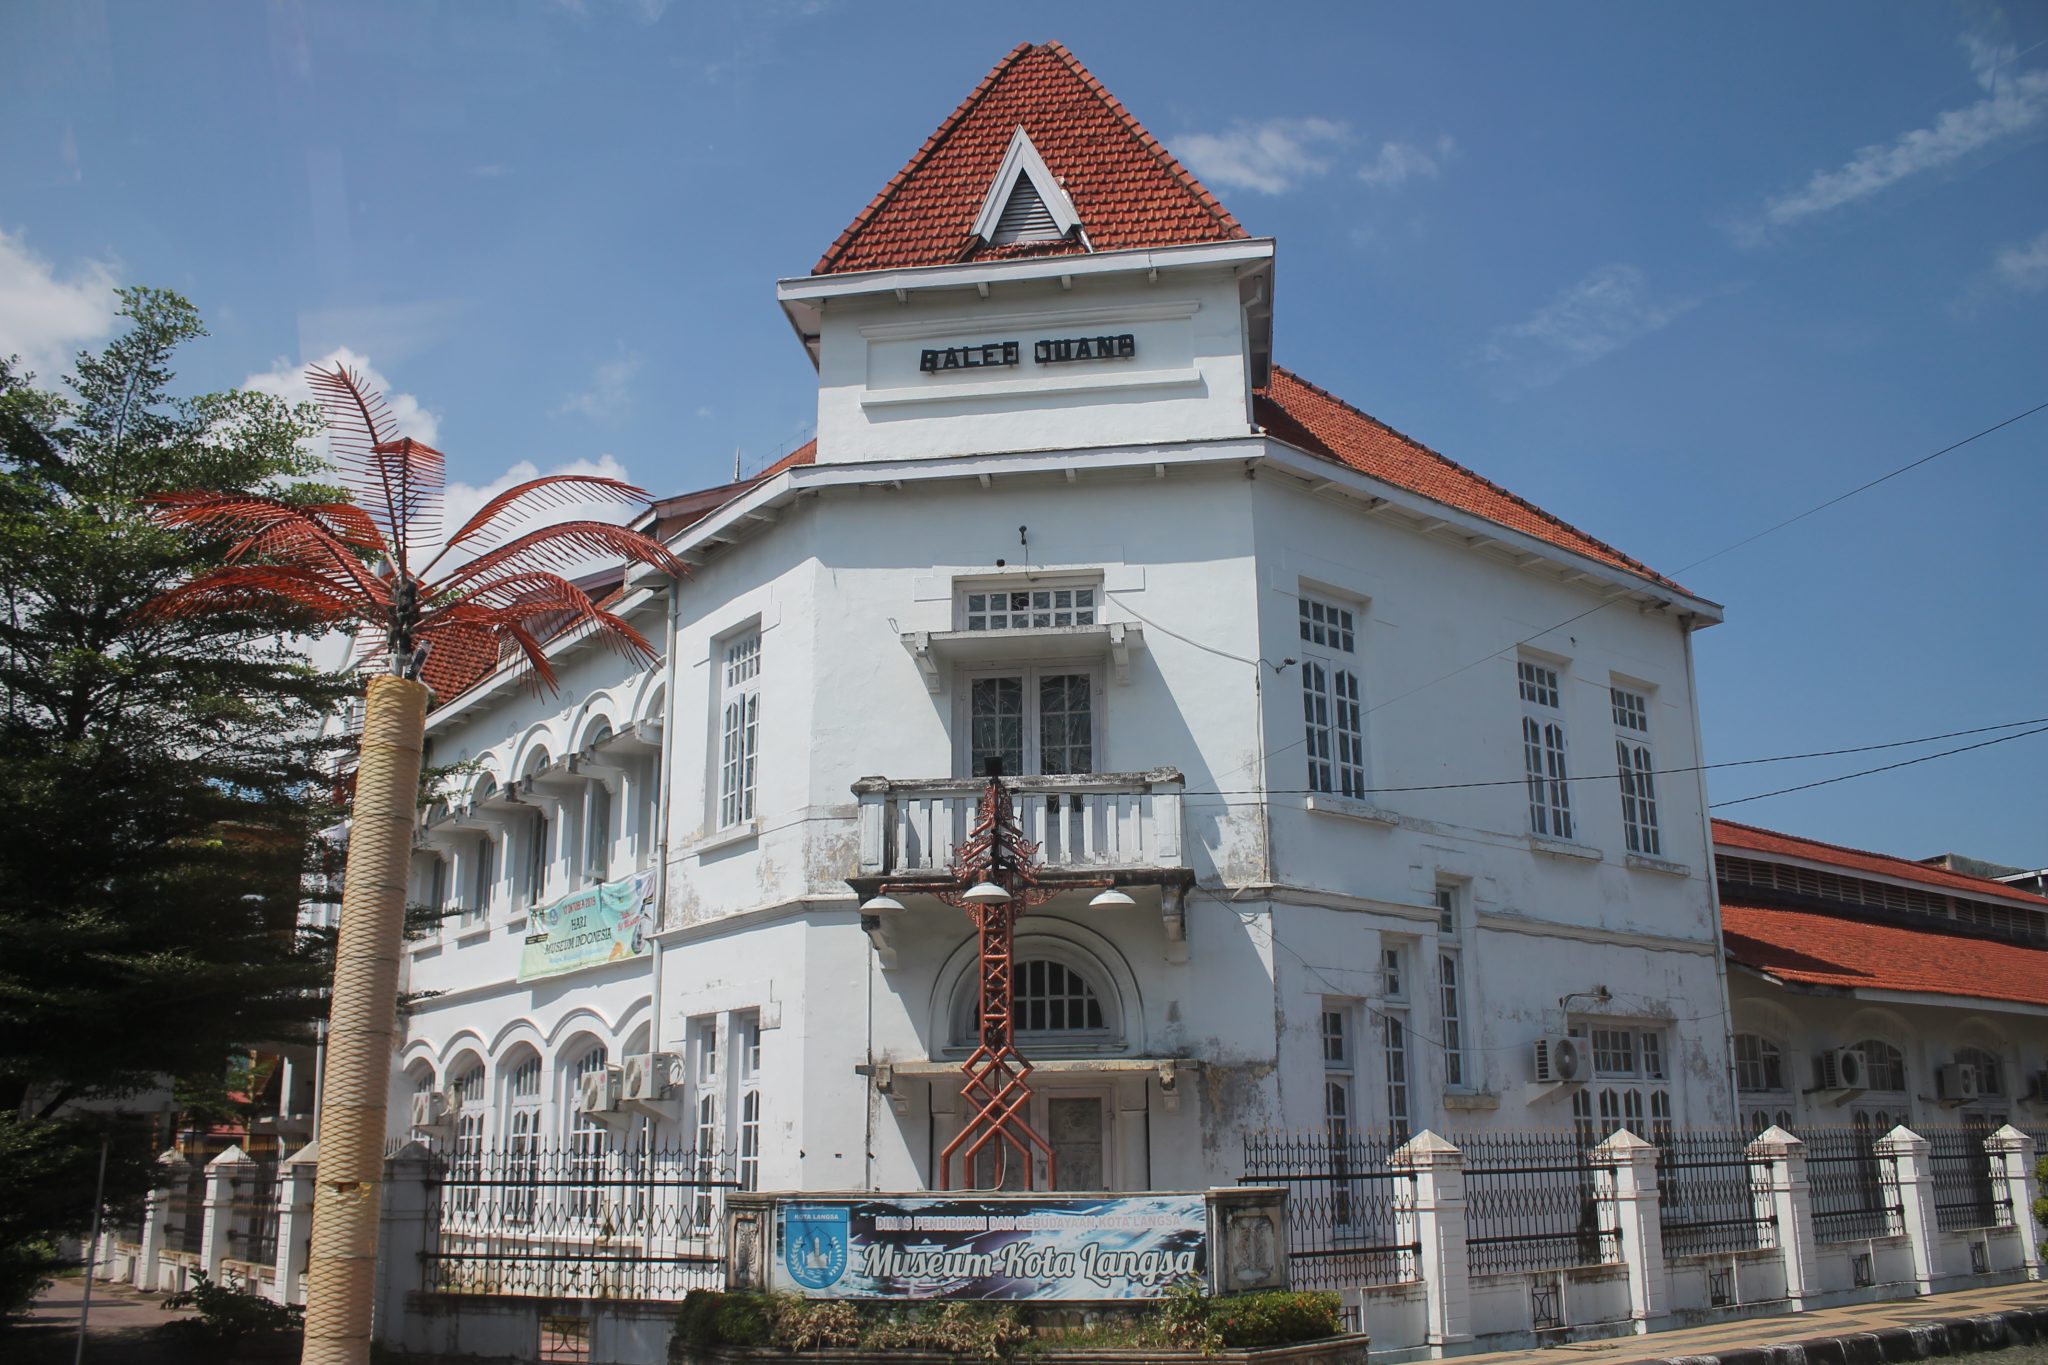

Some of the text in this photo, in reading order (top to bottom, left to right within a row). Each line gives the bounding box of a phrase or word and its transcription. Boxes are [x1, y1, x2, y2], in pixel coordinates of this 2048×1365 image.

[920, 341, 1019, 371] BALEE
[571, 915, 587, 931] HARI
[544, 937, 575, 955] MUSEUM
[574, 928, 612, 948] INDONESIA
[875, 1214, 1181, 1231] DINAS PENDIDIKAN DAN KEBUDAYAAN KOTA LANGSA
[862, 1241, 1197, 1288] Museum Kota Langsa
